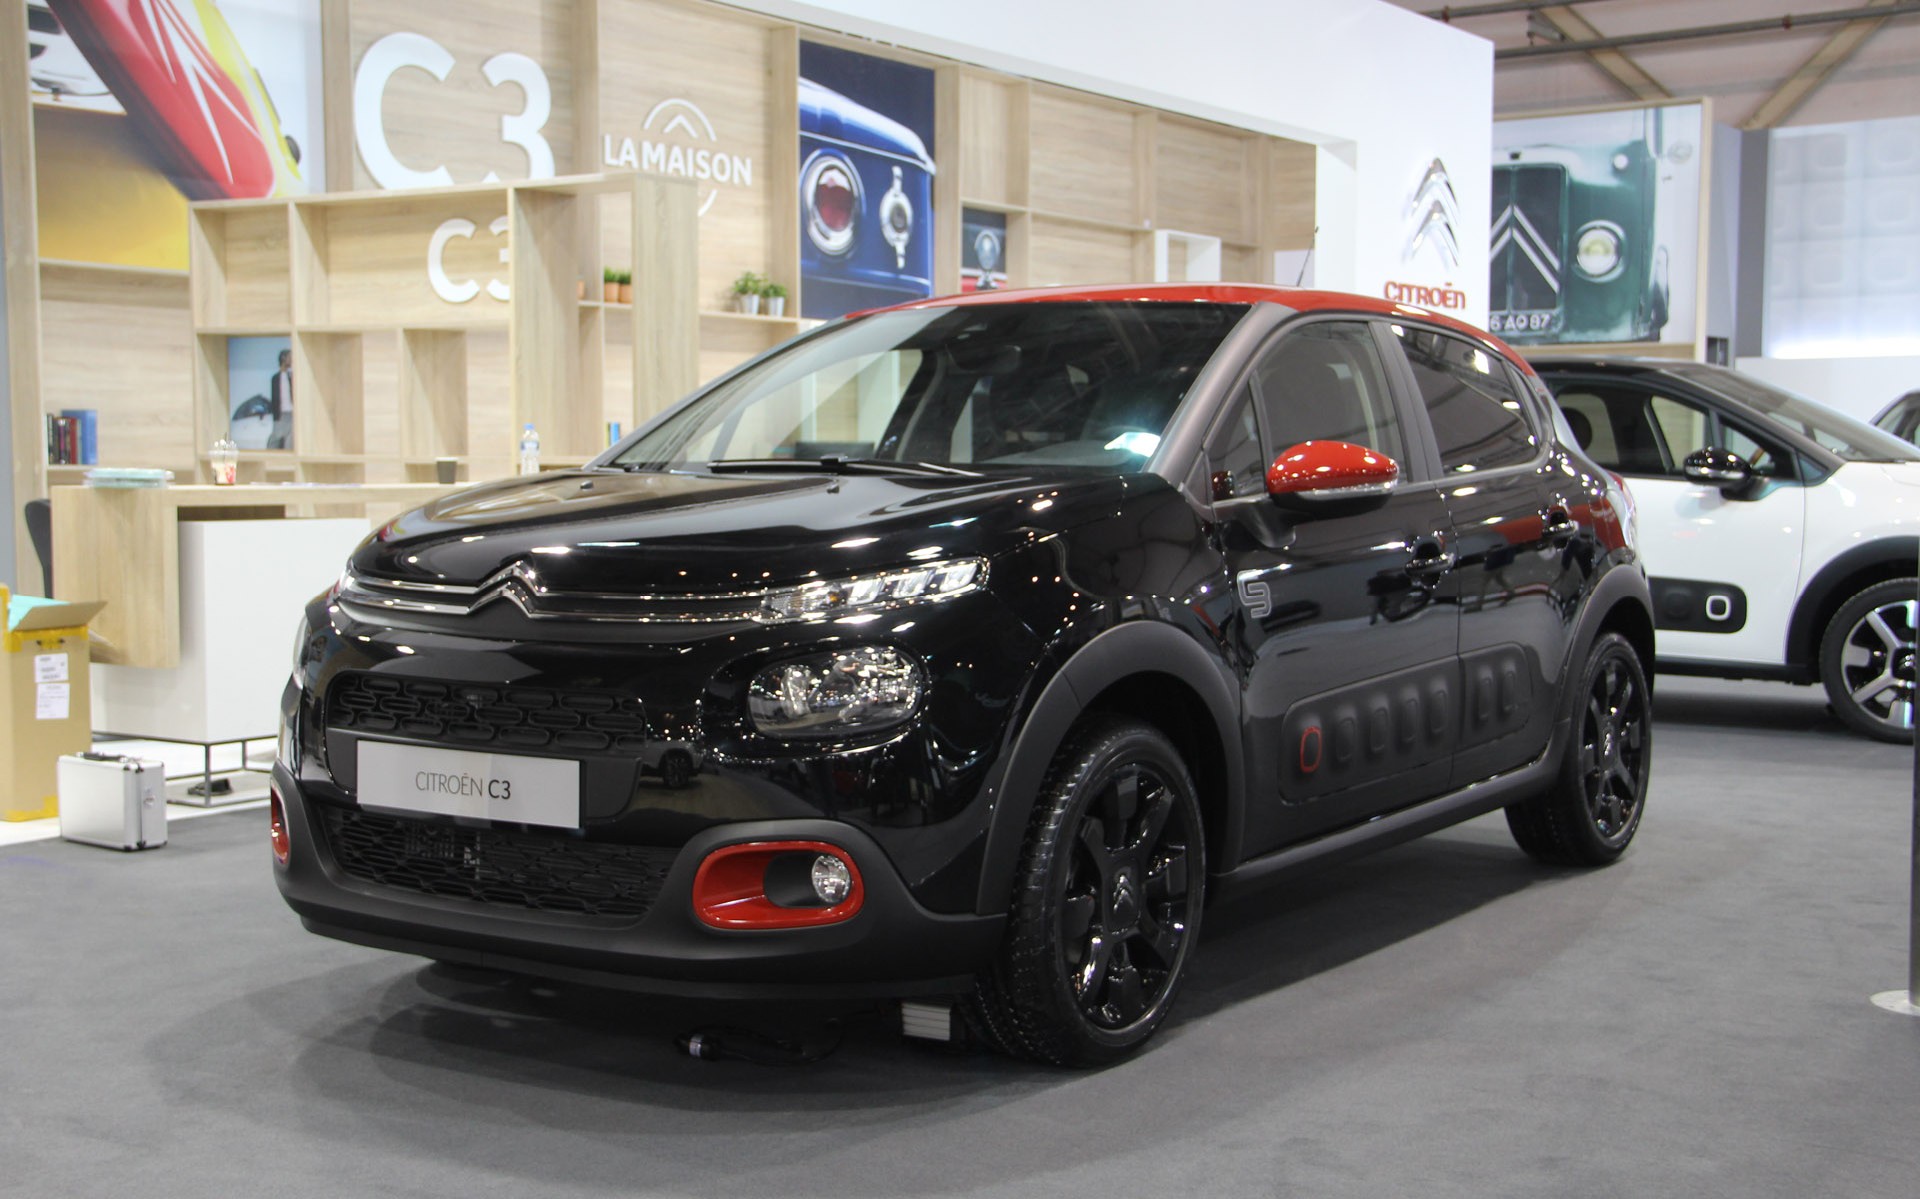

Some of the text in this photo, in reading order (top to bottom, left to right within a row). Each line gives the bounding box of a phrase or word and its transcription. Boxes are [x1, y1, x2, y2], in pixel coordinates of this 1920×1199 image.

[354, 32, 555, 189] C3
[415, 771, 511, 800] CITROËN C3
